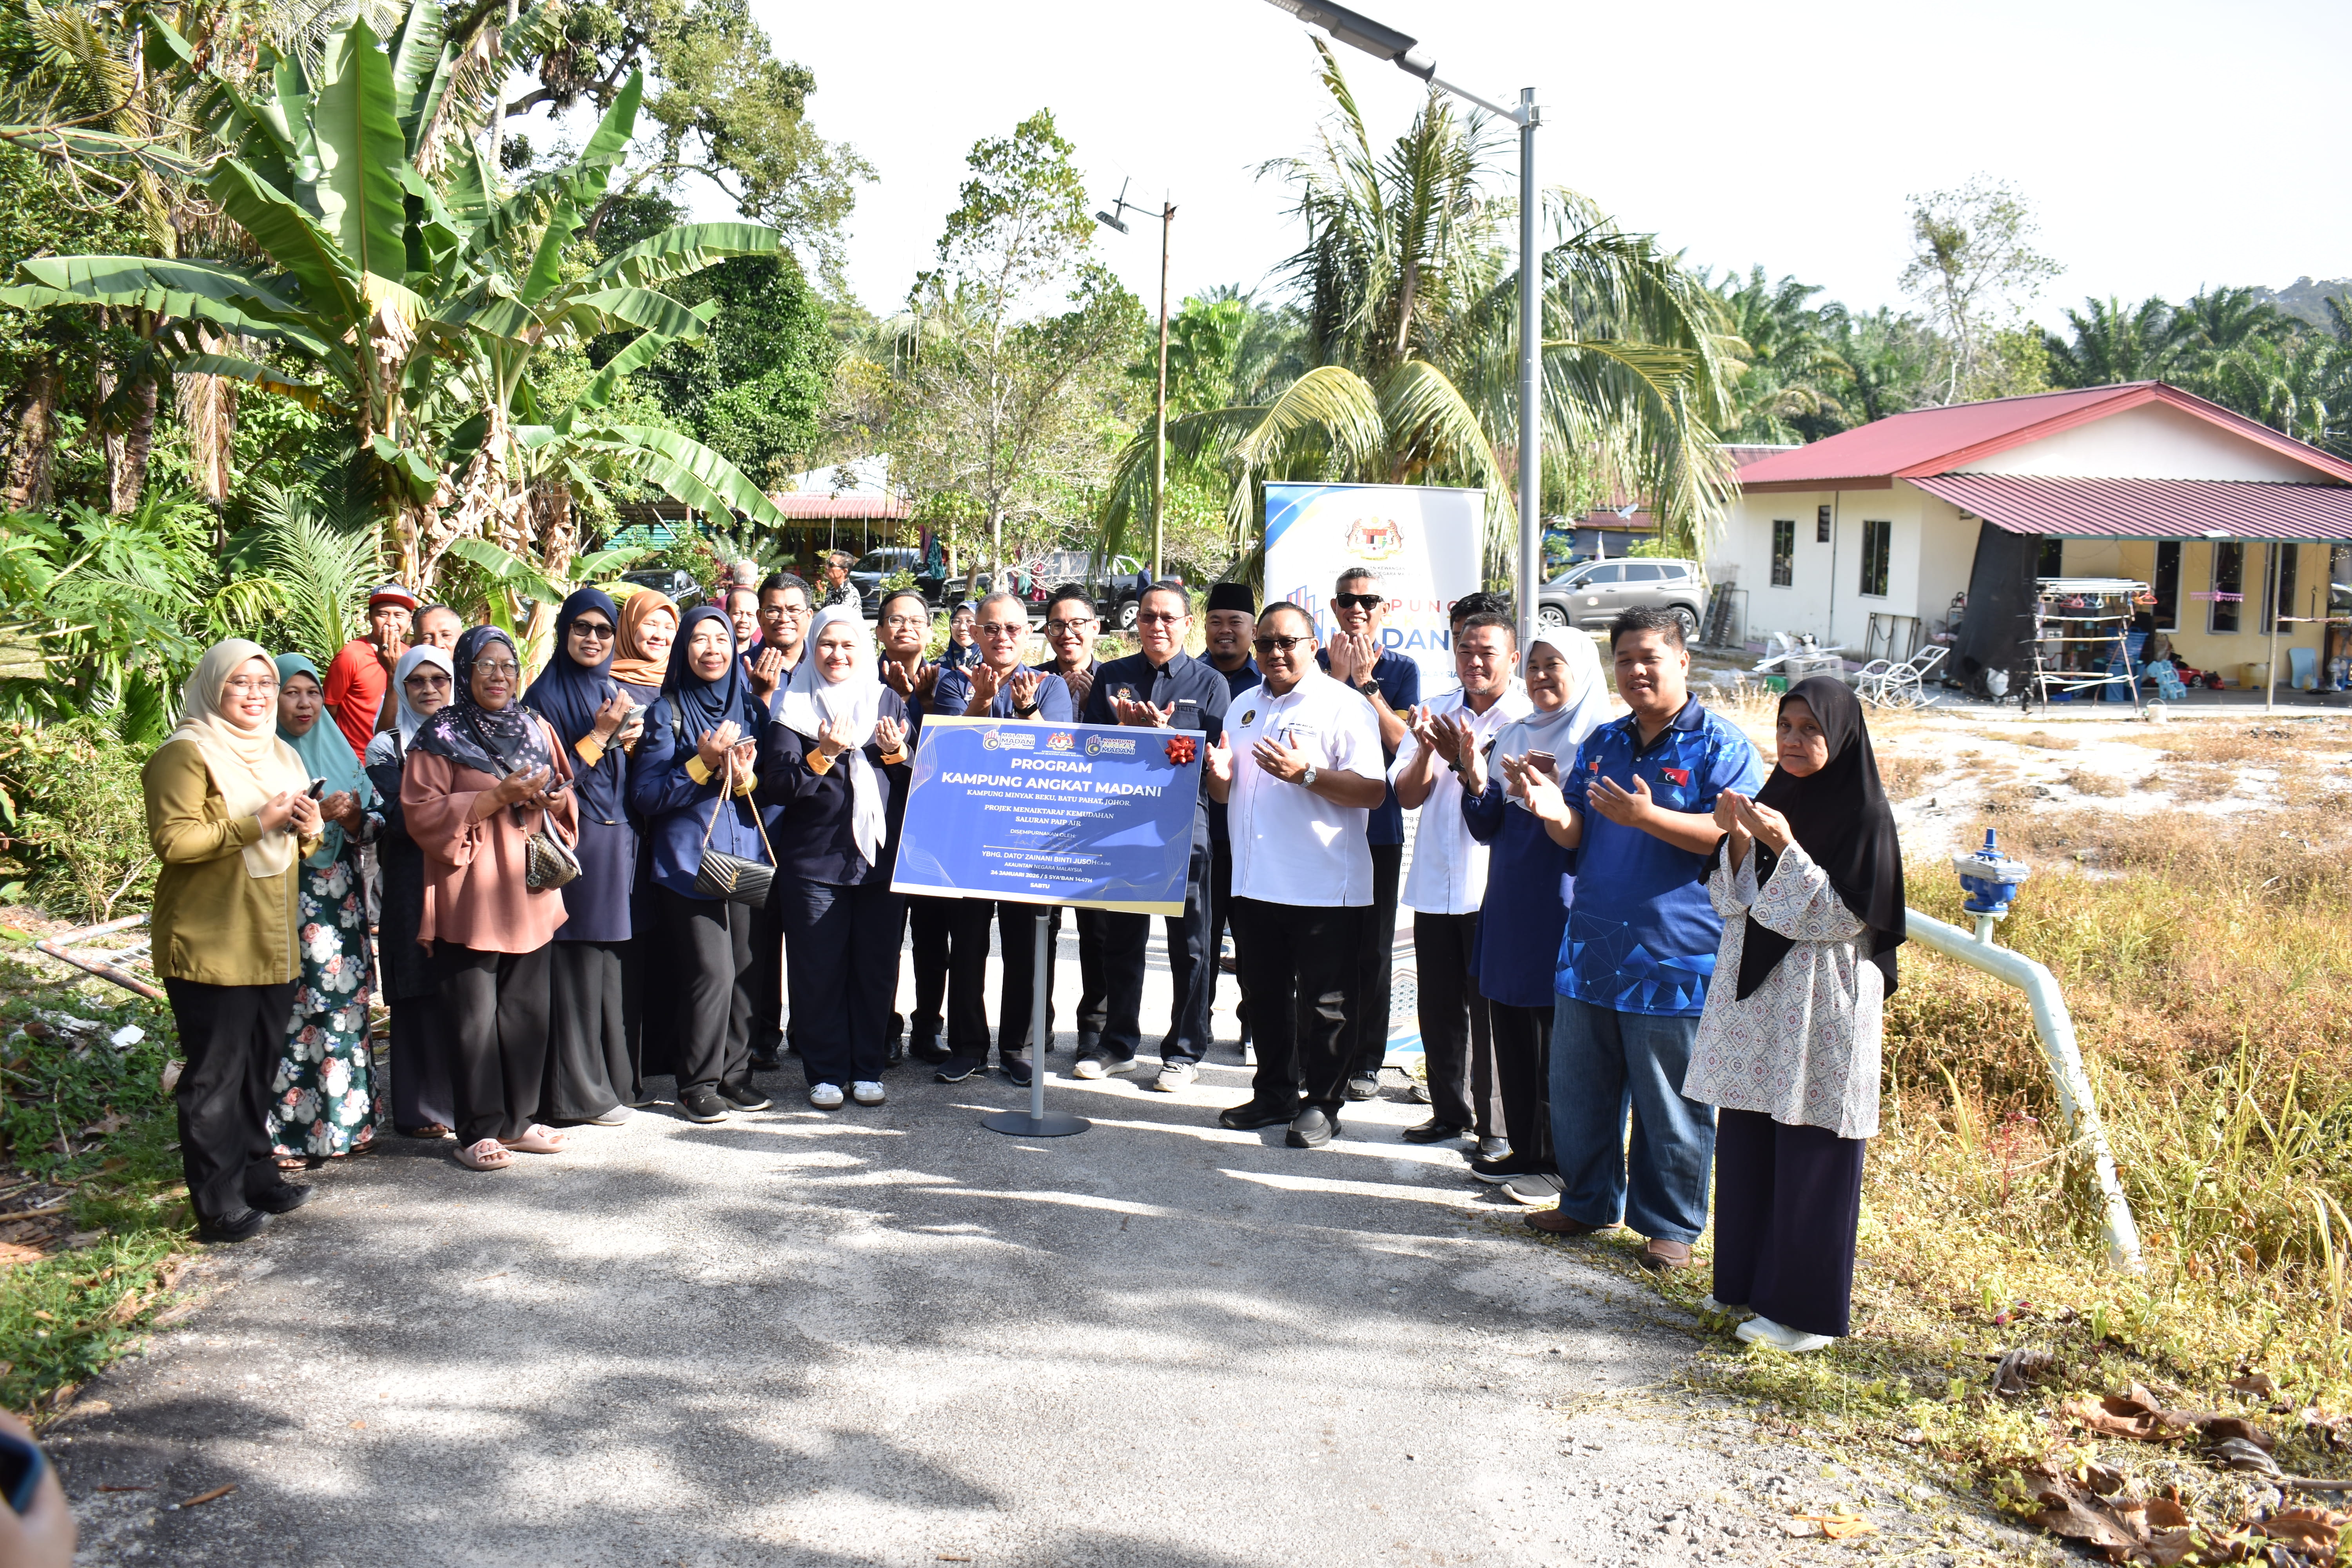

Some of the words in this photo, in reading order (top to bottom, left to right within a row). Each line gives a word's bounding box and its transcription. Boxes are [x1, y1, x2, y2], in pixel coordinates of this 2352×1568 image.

[1011, 758, 1093, 773] PROGRAM
[942, 771, 1022, 787] KAMPUNG
[1025, 777, 1093, 792] ANGKAT
[1095, 782, 1161, 797] MADANI
[1013, 806, 1065, 815] MENAIKTARAF
[1066, 809, 1114, 818] KEMUDAHAN
